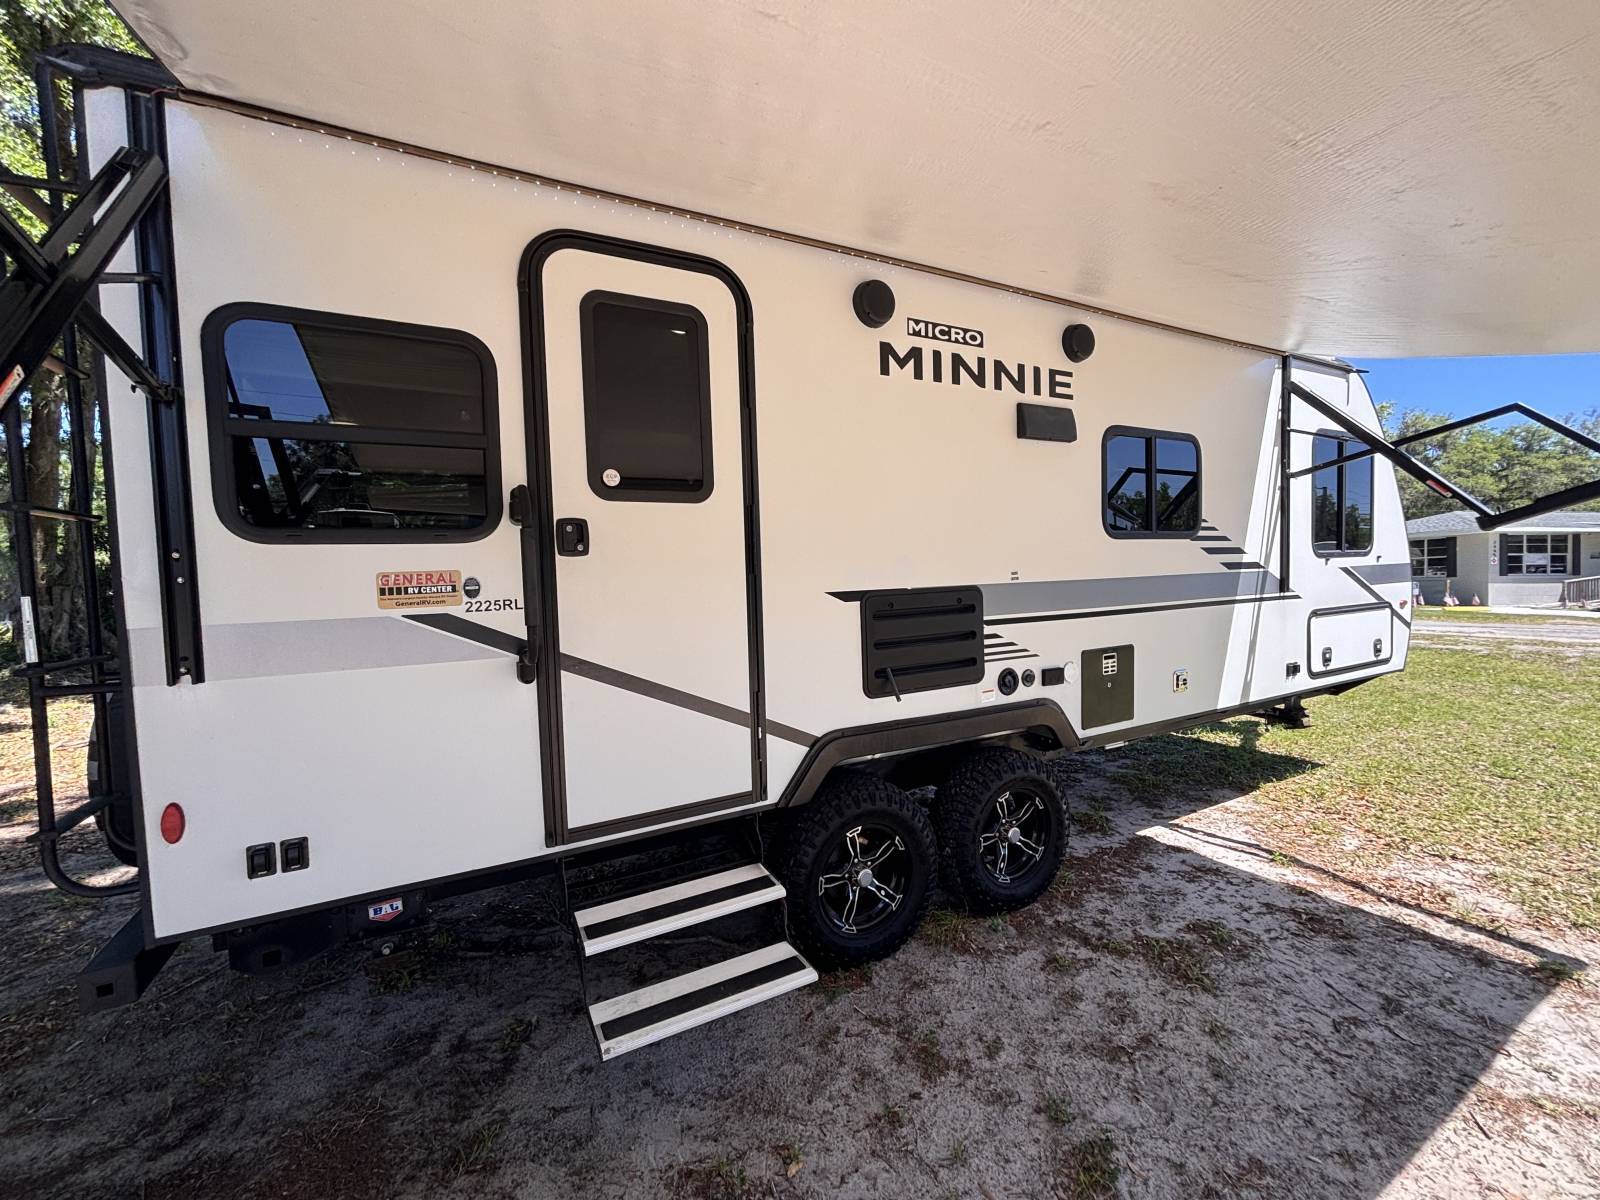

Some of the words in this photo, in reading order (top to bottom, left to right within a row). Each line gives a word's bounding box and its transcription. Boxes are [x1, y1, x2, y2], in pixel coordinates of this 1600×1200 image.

[908, 319, 982, 346] MICRO
[879, 341, 1074, 400] MINNIE
[380, 573, 457, 587] GENERAL
[395, 599, 447, 607] GeneralRV.com
[464, 598, 524, 613] 2225RL
